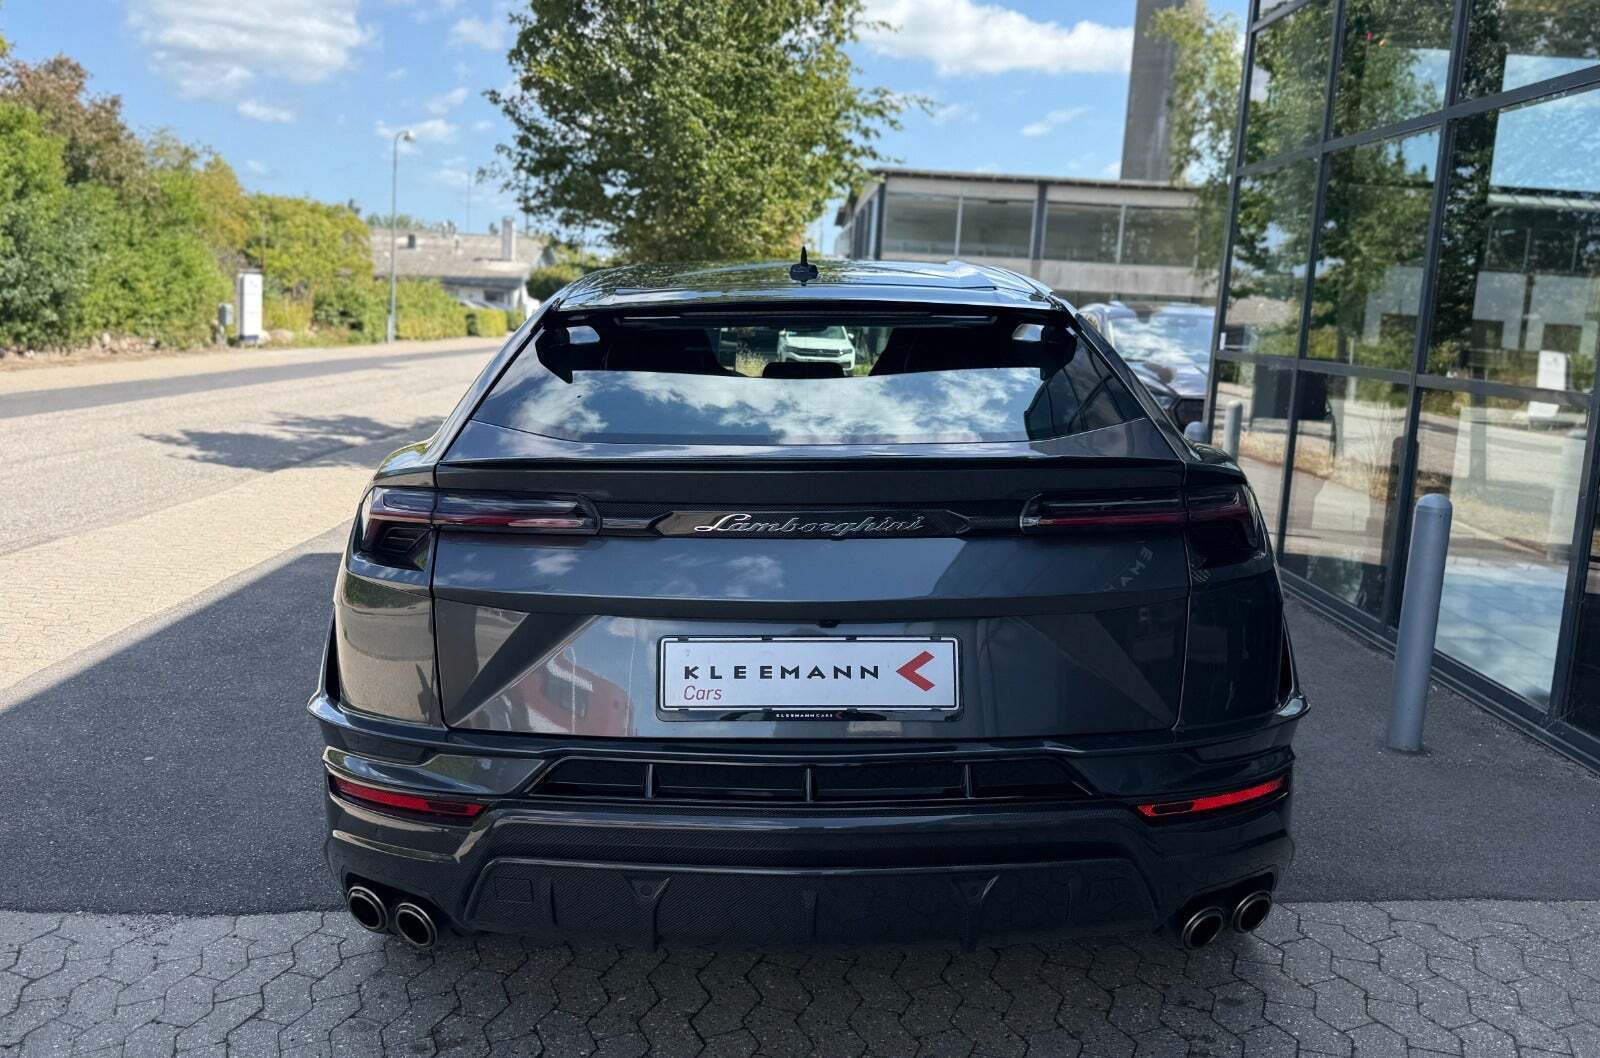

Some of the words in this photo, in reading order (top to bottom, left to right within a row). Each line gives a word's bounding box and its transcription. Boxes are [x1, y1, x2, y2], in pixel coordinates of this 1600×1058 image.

[693, 513, 925, 536] Lamborghini
[684, 665, 879, 680] KLEEMANN
[683, 685, 723, 701] Cars
